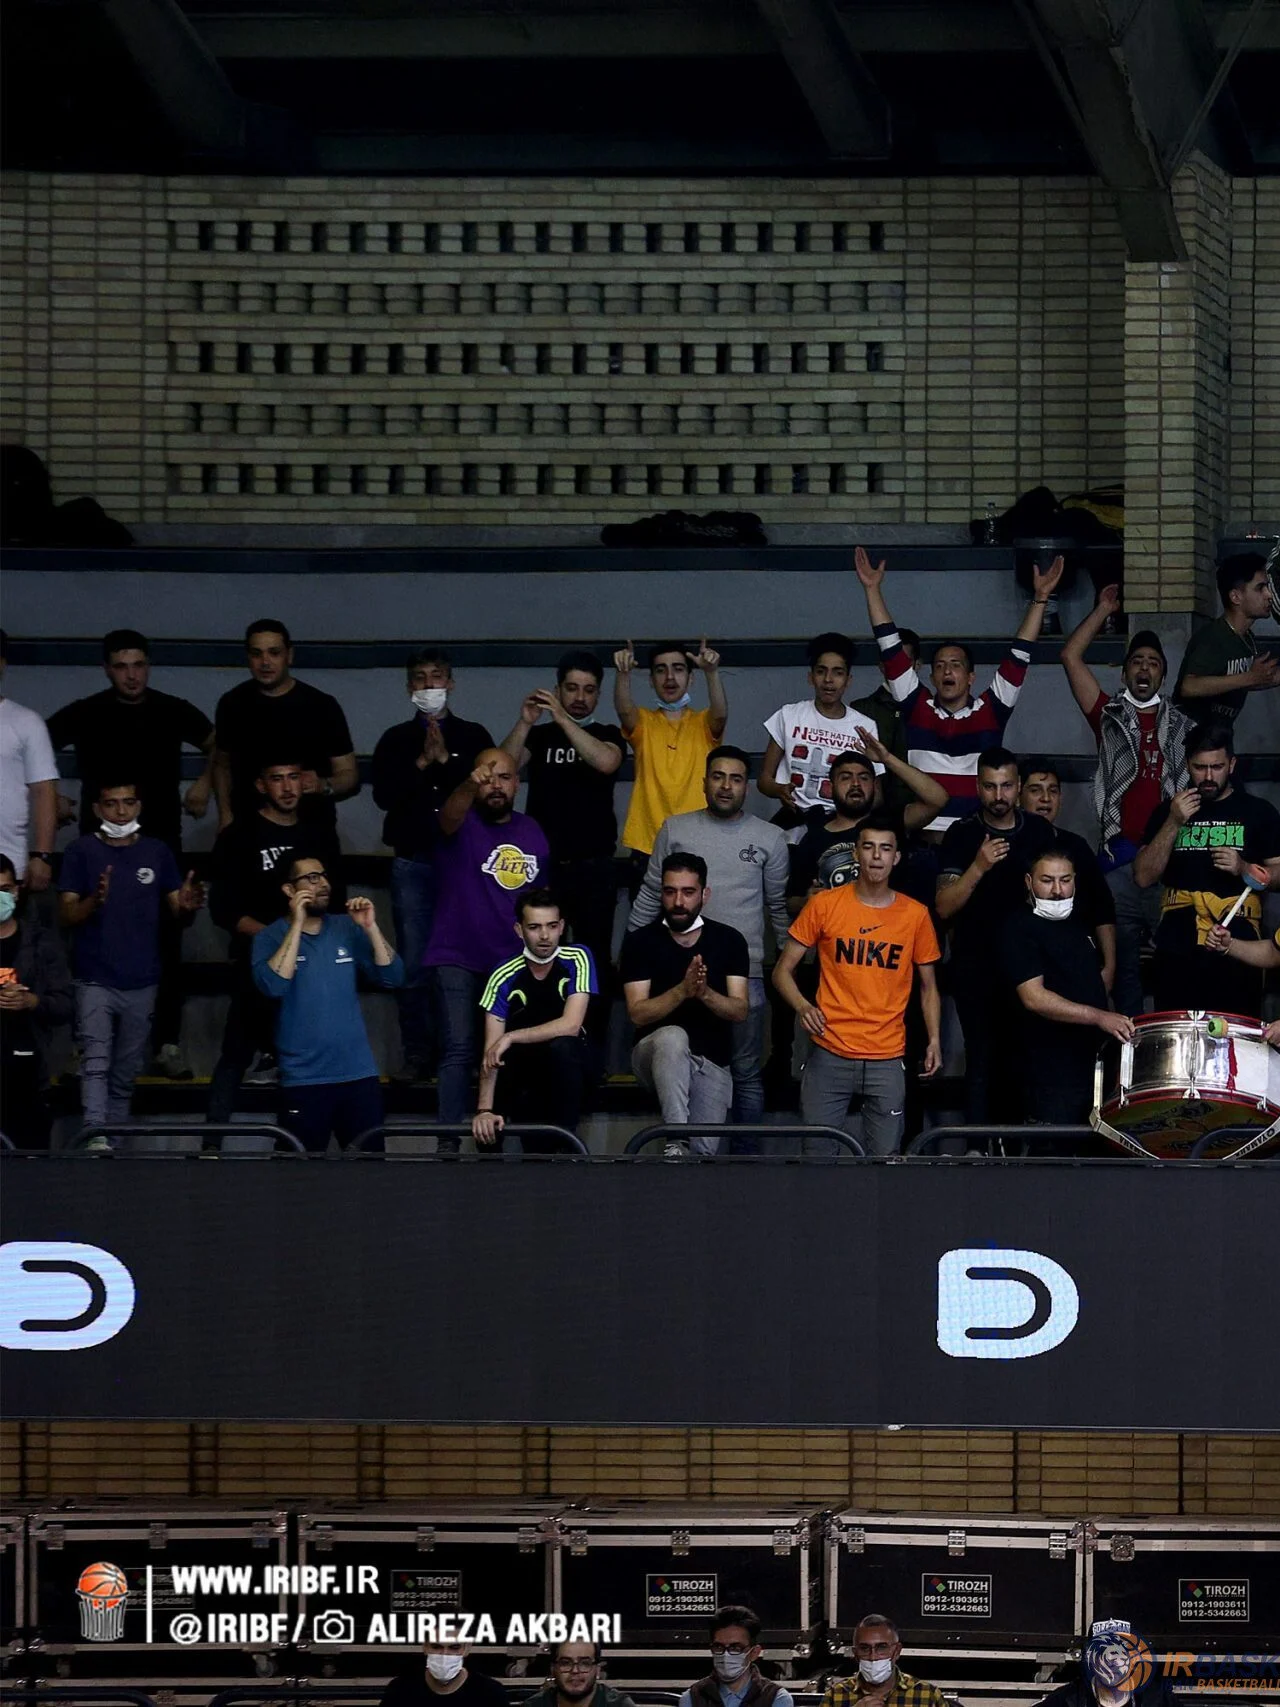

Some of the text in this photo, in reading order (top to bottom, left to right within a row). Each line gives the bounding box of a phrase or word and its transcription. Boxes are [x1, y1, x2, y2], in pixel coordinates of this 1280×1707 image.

[546, 747, 583, 764] ICO
[835, 937, 904, 971] NIKE
[416, 1576, 458, 1586] TIROZH
[672, 1580, 714, 1590] TIROZH
[947, 1580, 988, 1591] TIROZH
[1204, 1585, 1246, 1595] TIROZH
[924, 1595, 988, 1604] 0912-1903611
[648, 1604, 715, 1612] 0912-5342663
[924, 1603, 989, 1613] 0912-5342663
[1181, 1609, 1247, 1617] 0912-5342663
